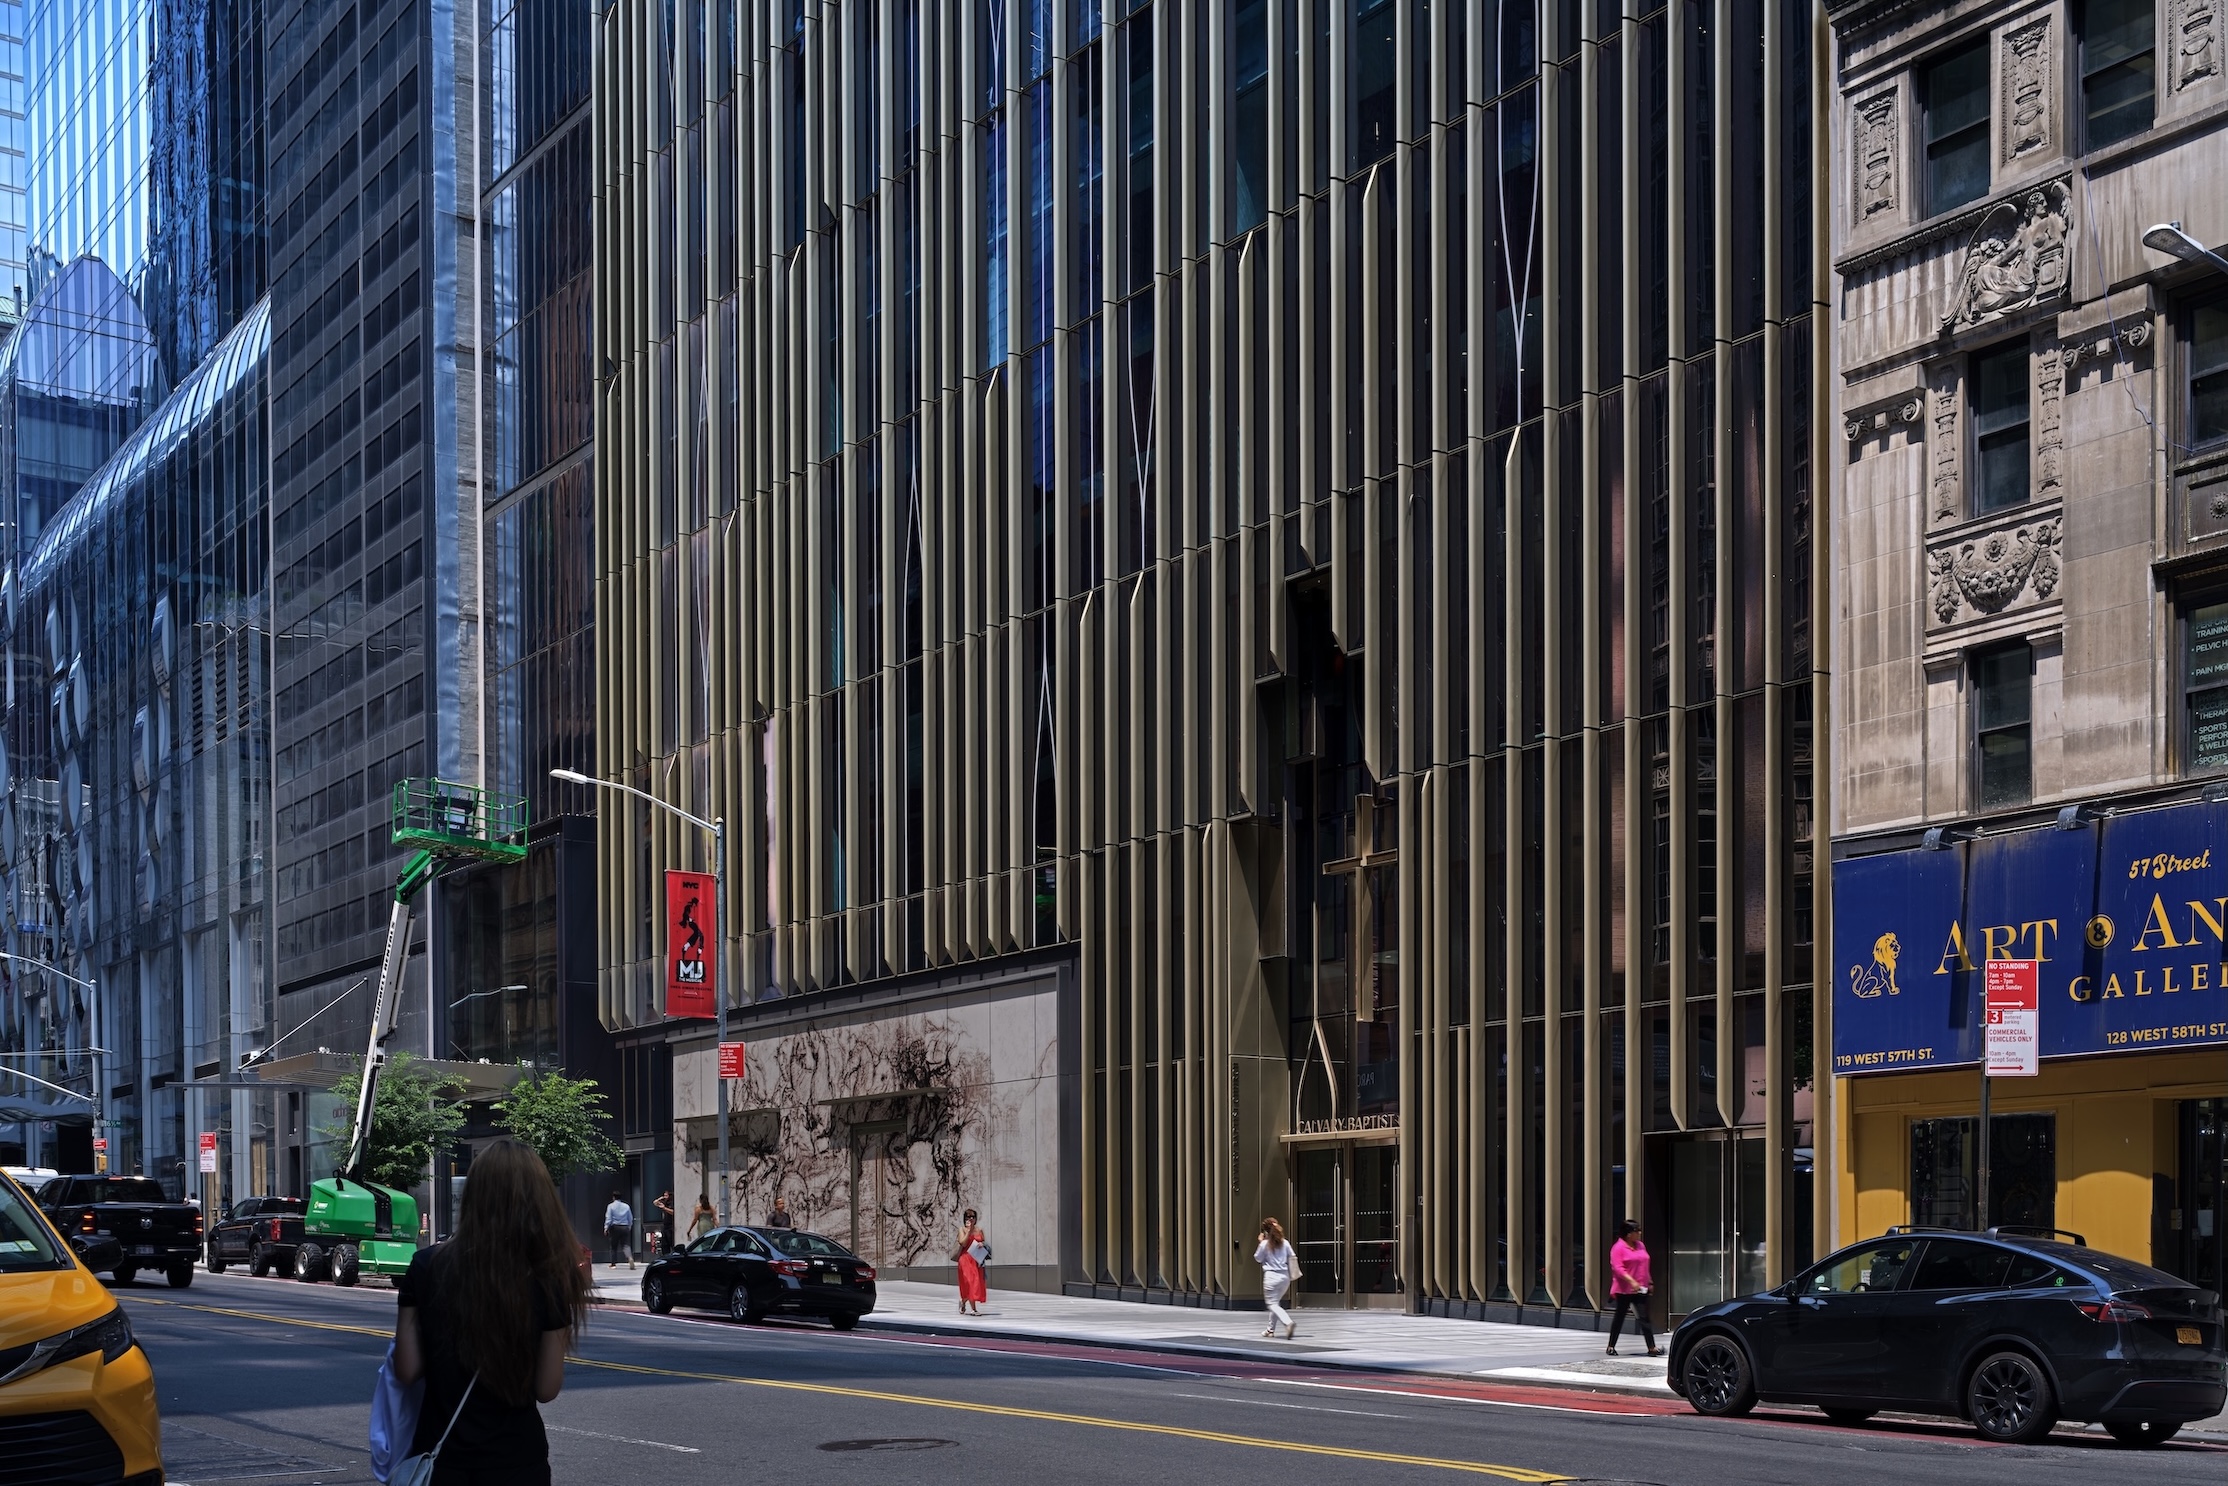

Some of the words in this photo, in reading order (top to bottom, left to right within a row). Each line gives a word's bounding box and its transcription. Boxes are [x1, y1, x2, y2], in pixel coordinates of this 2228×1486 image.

[2196, 641, 2221, 652] PELVIC
[2196, 666, 2213, 676] PAIN
[2199, 722, 2228, 734] SPORTS
[2199, 743, 2204, 752] &
[2199, 752, 2228, 764] SPORTS
[2128, 858, 2151, 879] 57
[682, 881, 700, 890] NYC
[1933, 918, 2058, 974] ART
[680, 960, 704, 979] MJ
[1990, 1011, 1999, 1023] 3
[2107, 1031, 2128, 1045] 128
[2131, 1027, 2169, 1042] WEST
[2172, 1024, 2206, 1039] 58TH
[2210, 1022, 2228, 1036] ST.
[1836, 1054, 1852, 1067] 119
[1854, 1052, 1885, 1065] WEST
[1888, 1048, 1915, 1062] 57TH
[1918, 1047, 1935, 1060] ST.
[1297, 1117, 1346, 1134] CALVARY
[1348, 1114, 1395, 1131] BAPTIST
